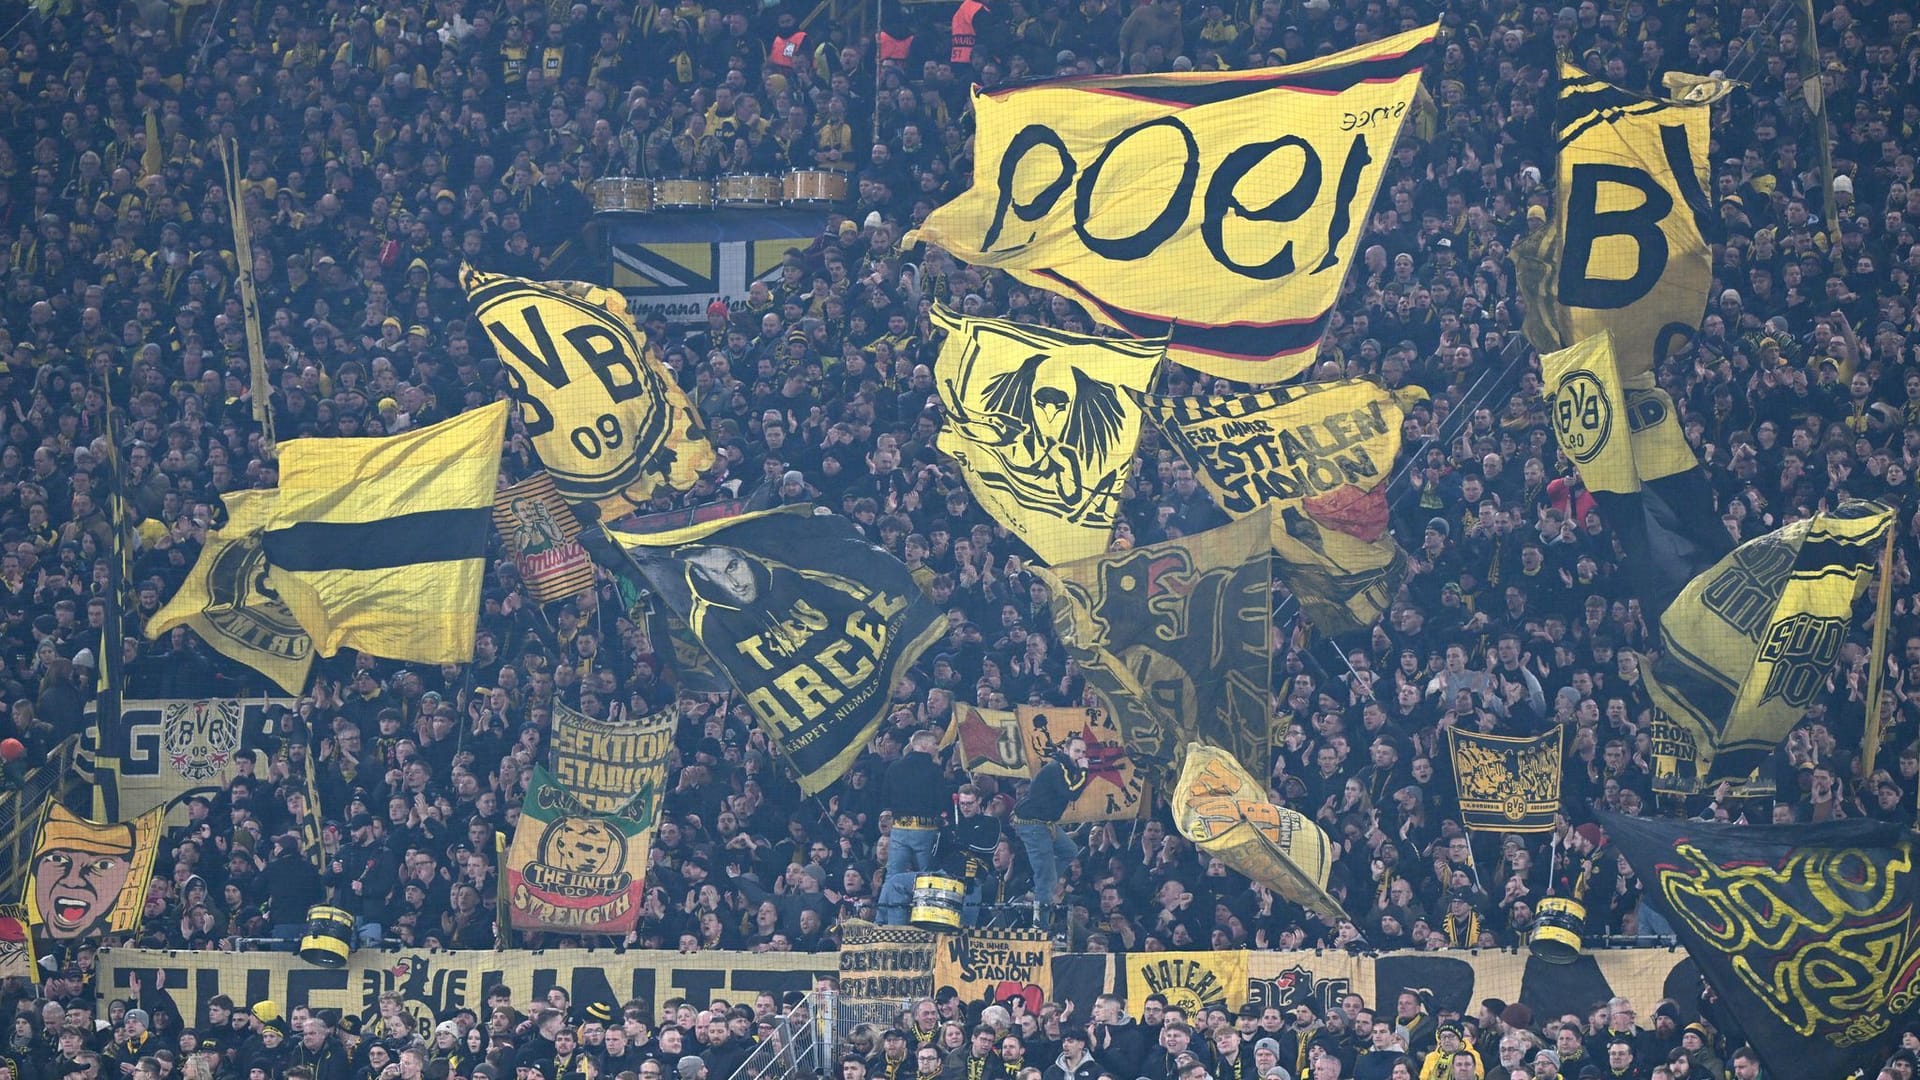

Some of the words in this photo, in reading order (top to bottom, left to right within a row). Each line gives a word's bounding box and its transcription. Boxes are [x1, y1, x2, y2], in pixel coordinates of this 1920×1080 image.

[571, 413, 624, 460] 09
[1221, 419, 1275, 441] IMMER
[1759, 614, 1844, 666] SÜD
[836, 679, 880, 721] NIEMALS
[558, 727, 672, 764] SEKTION
[1507, 798, 1524, 813] BVB
[534, 865, 568, 885] THE
[570, 873, 622, 889] UNITY
[514, 883, 632, 926] STRENGTH
[840, 949, 935, 971] SEKTION
[948, 933, 1044, 967] WESTFALEN
[970, 941, 986, 950] FÜR
[987, 942, 1010, 950] IMMER
[960, 965, 1032, 983] STADION
[481, 968, 839, 1027] UNIT
